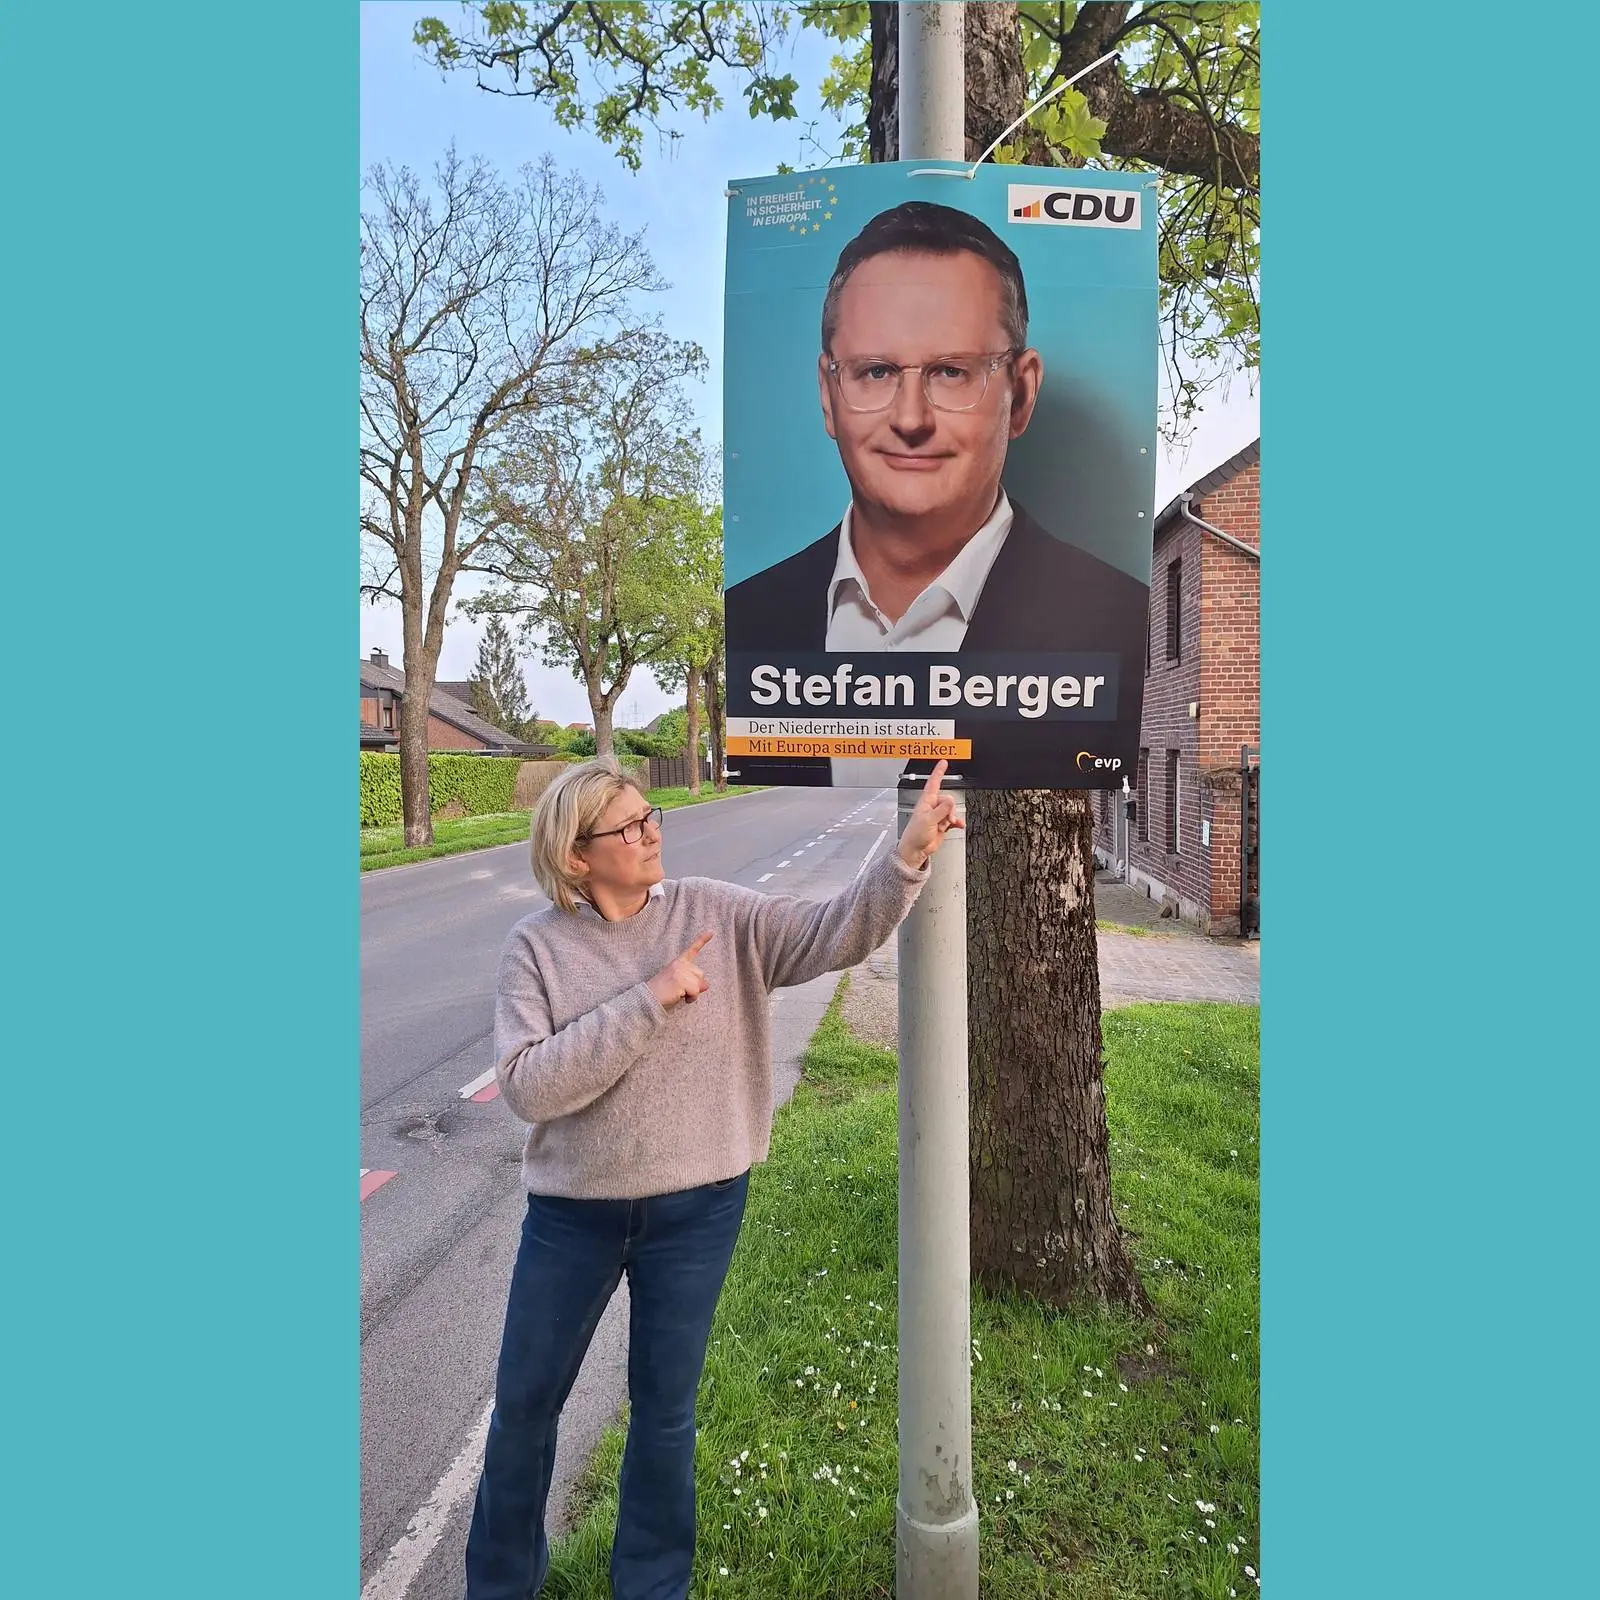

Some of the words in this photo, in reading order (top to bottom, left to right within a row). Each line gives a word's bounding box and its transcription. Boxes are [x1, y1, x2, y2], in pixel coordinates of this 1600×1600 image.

[747, 196, 757, 206] IN
[760, 191, 806, 205] FREIHEIT.
[746, 207, 757, 217] IN
[759, 199, 822, 216] SICHERHEIT.
[1043, 192, 1136, 223] CDU
[753, 217, 764, 227] IN
[765, 211, 810, 226] EUROPA.
[750, 663, 915, 706] Stefan
[929, 665, 1105, 719] Berger
[749, 721, 775, 735] Der
[778, 721, 870, 736] Niederrhein
[875, 721, 892, 736] ist
[896, 722, 941, 736] stark.
[749, 740, 772, 753] Mit
[776, 740, 830, 757] Europa
[834, 741, 866, 755] sind
[870, 741, 896, 755] wir
[899, 742, 958, 756] stärker.
[1094, 756, 1121, 772] evp
